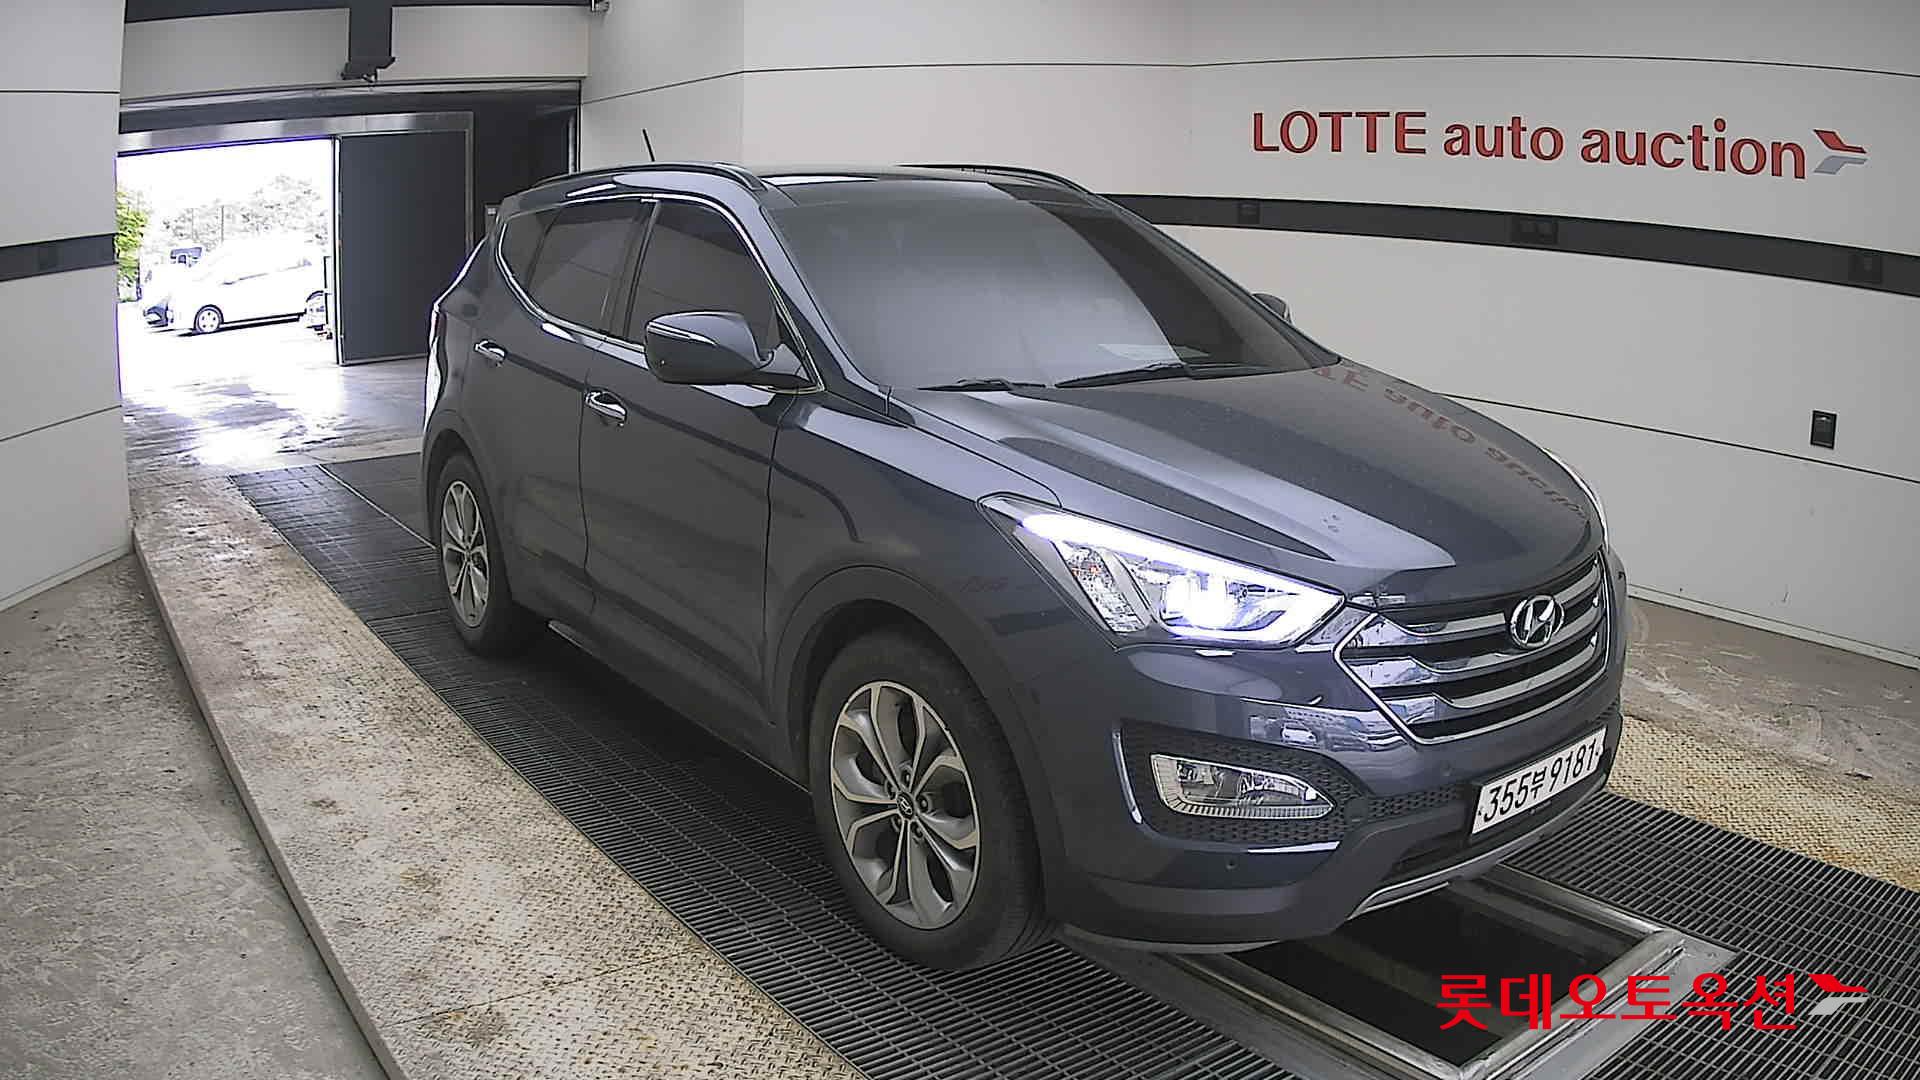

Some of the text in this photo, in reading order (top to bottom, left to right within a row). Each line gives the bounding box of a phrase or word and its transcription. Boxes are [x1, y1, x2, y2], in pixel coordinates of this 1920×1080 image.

[1253, 111, 1806, 179] LOTTE auto auction
